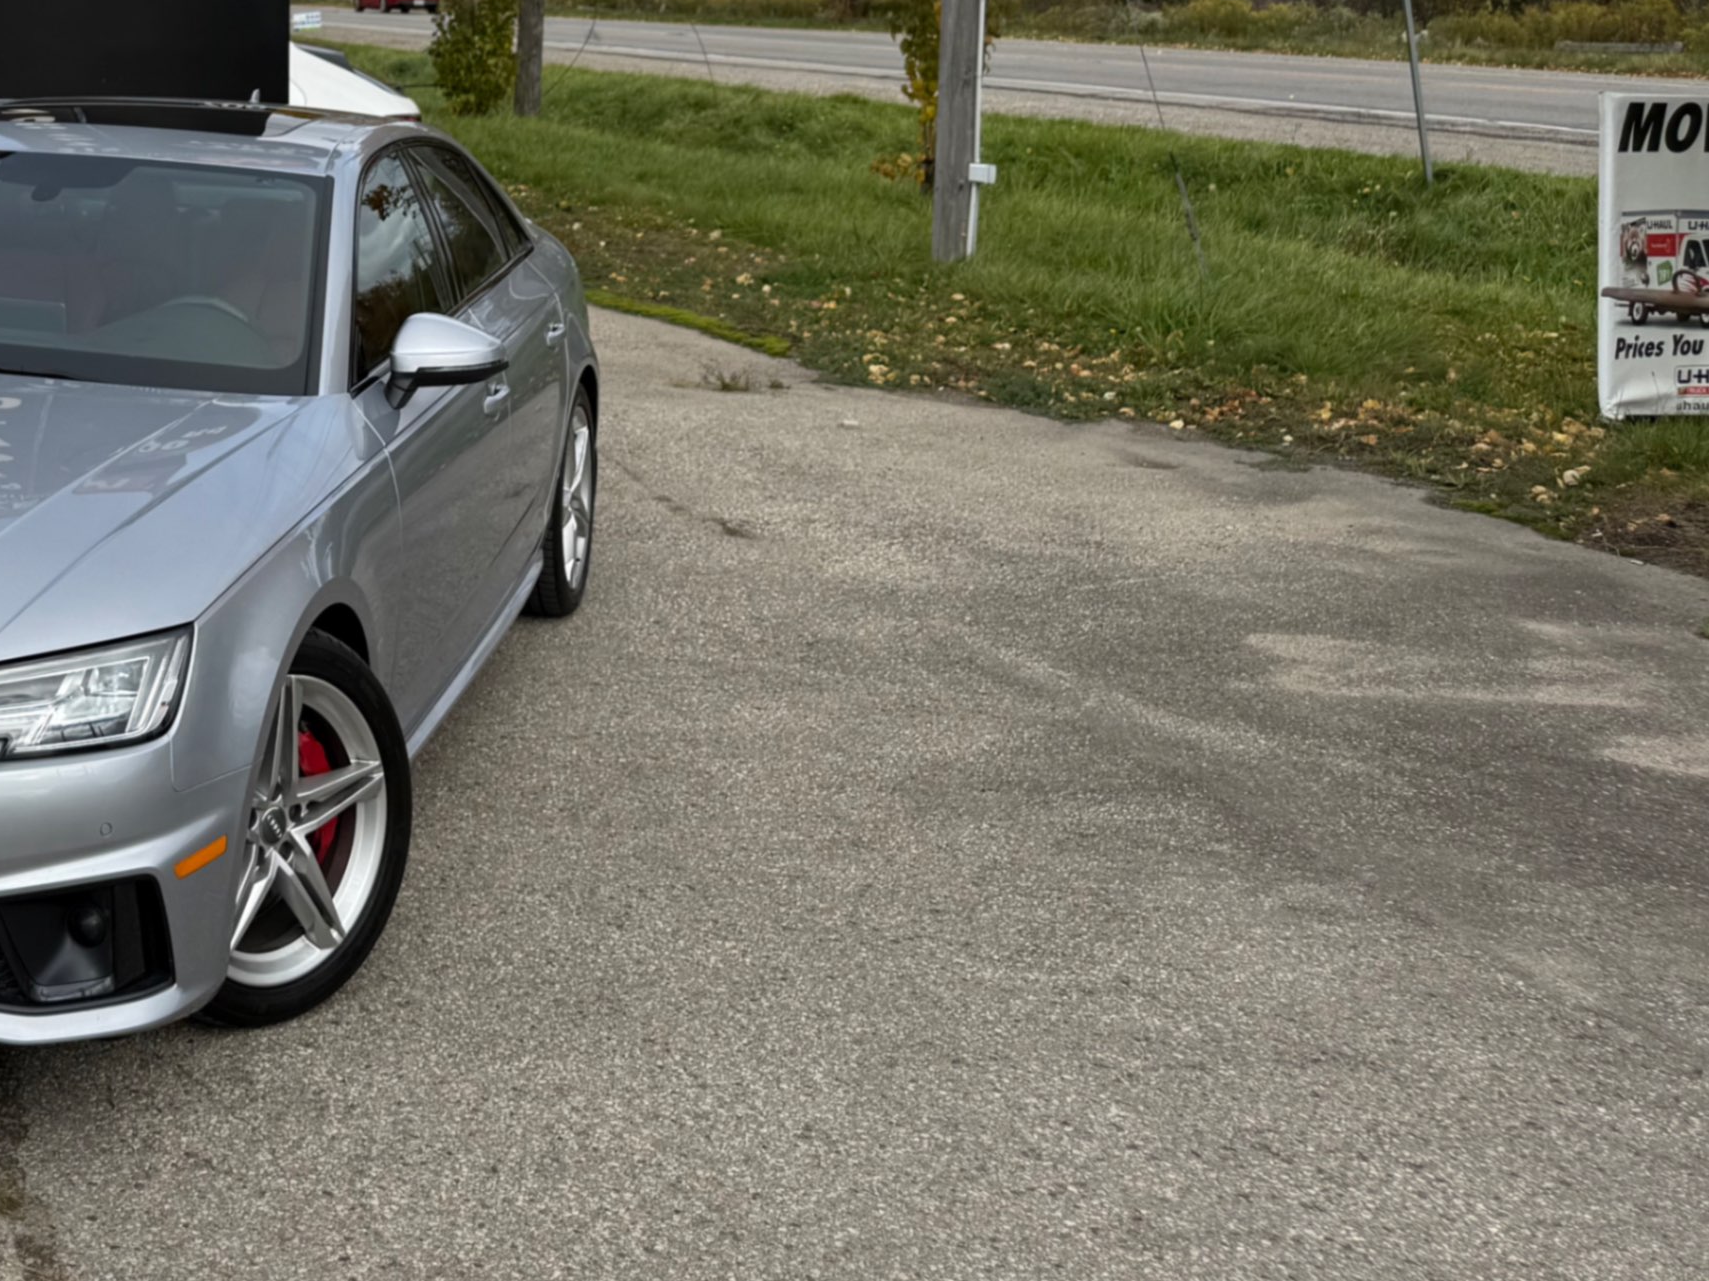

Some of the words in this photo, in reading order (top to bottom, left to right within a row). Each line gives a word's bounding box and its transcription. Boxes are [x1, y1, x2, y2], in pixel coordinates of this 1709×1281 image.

[1617, 102, 1709, 153] MO
[1615, 335, 1665, 360] Prices
[1672, 333, 1704, 356] You
